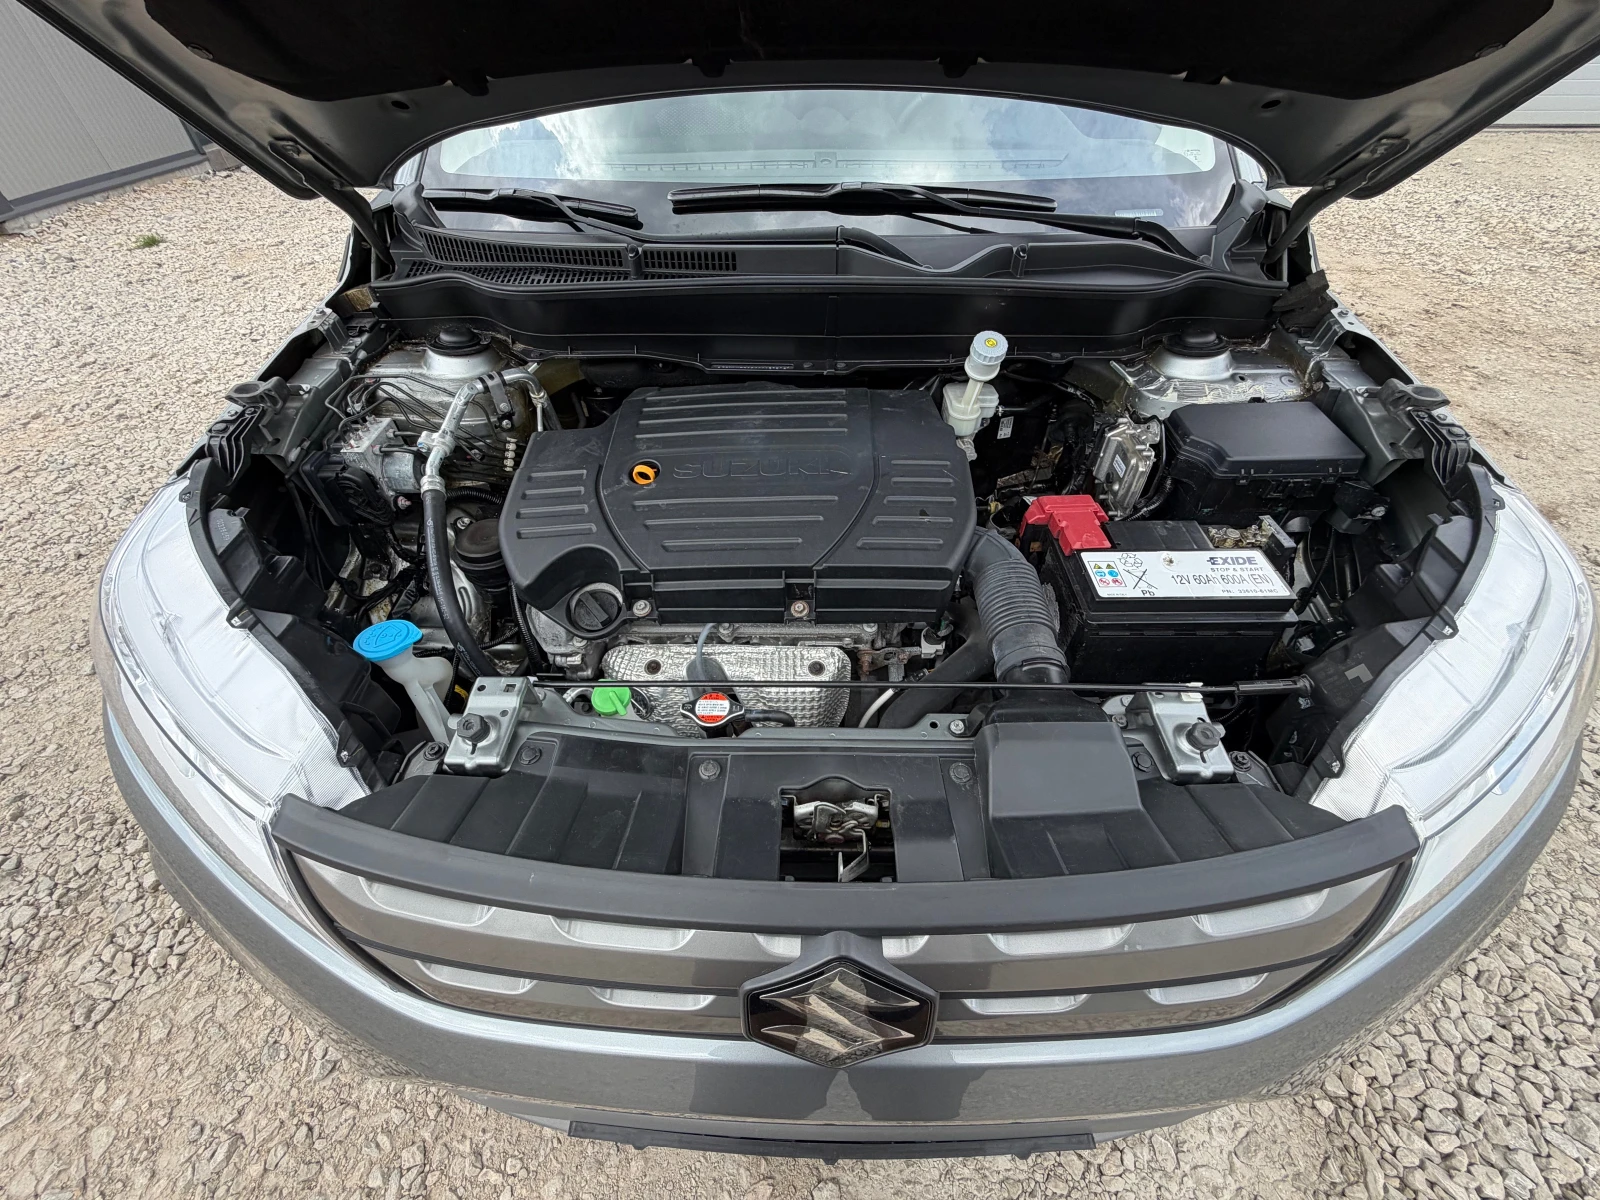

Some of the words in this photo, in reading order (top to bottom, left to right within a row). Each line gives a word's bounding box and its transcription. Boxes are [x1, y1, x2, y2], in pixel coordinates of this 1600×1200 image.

[672, 459, 831, 479] SUZUKI
[1206, 556, 1258, 566] EXIDE
[1171, 574, 1191, 585] 12V
[1192, 574, 1221, 585] 60Ah
[1220, 574, 1250, 585] 600A
[1247, 573, 1275, 589] (EN)
[1141, 589, 1156, 597] Pb
